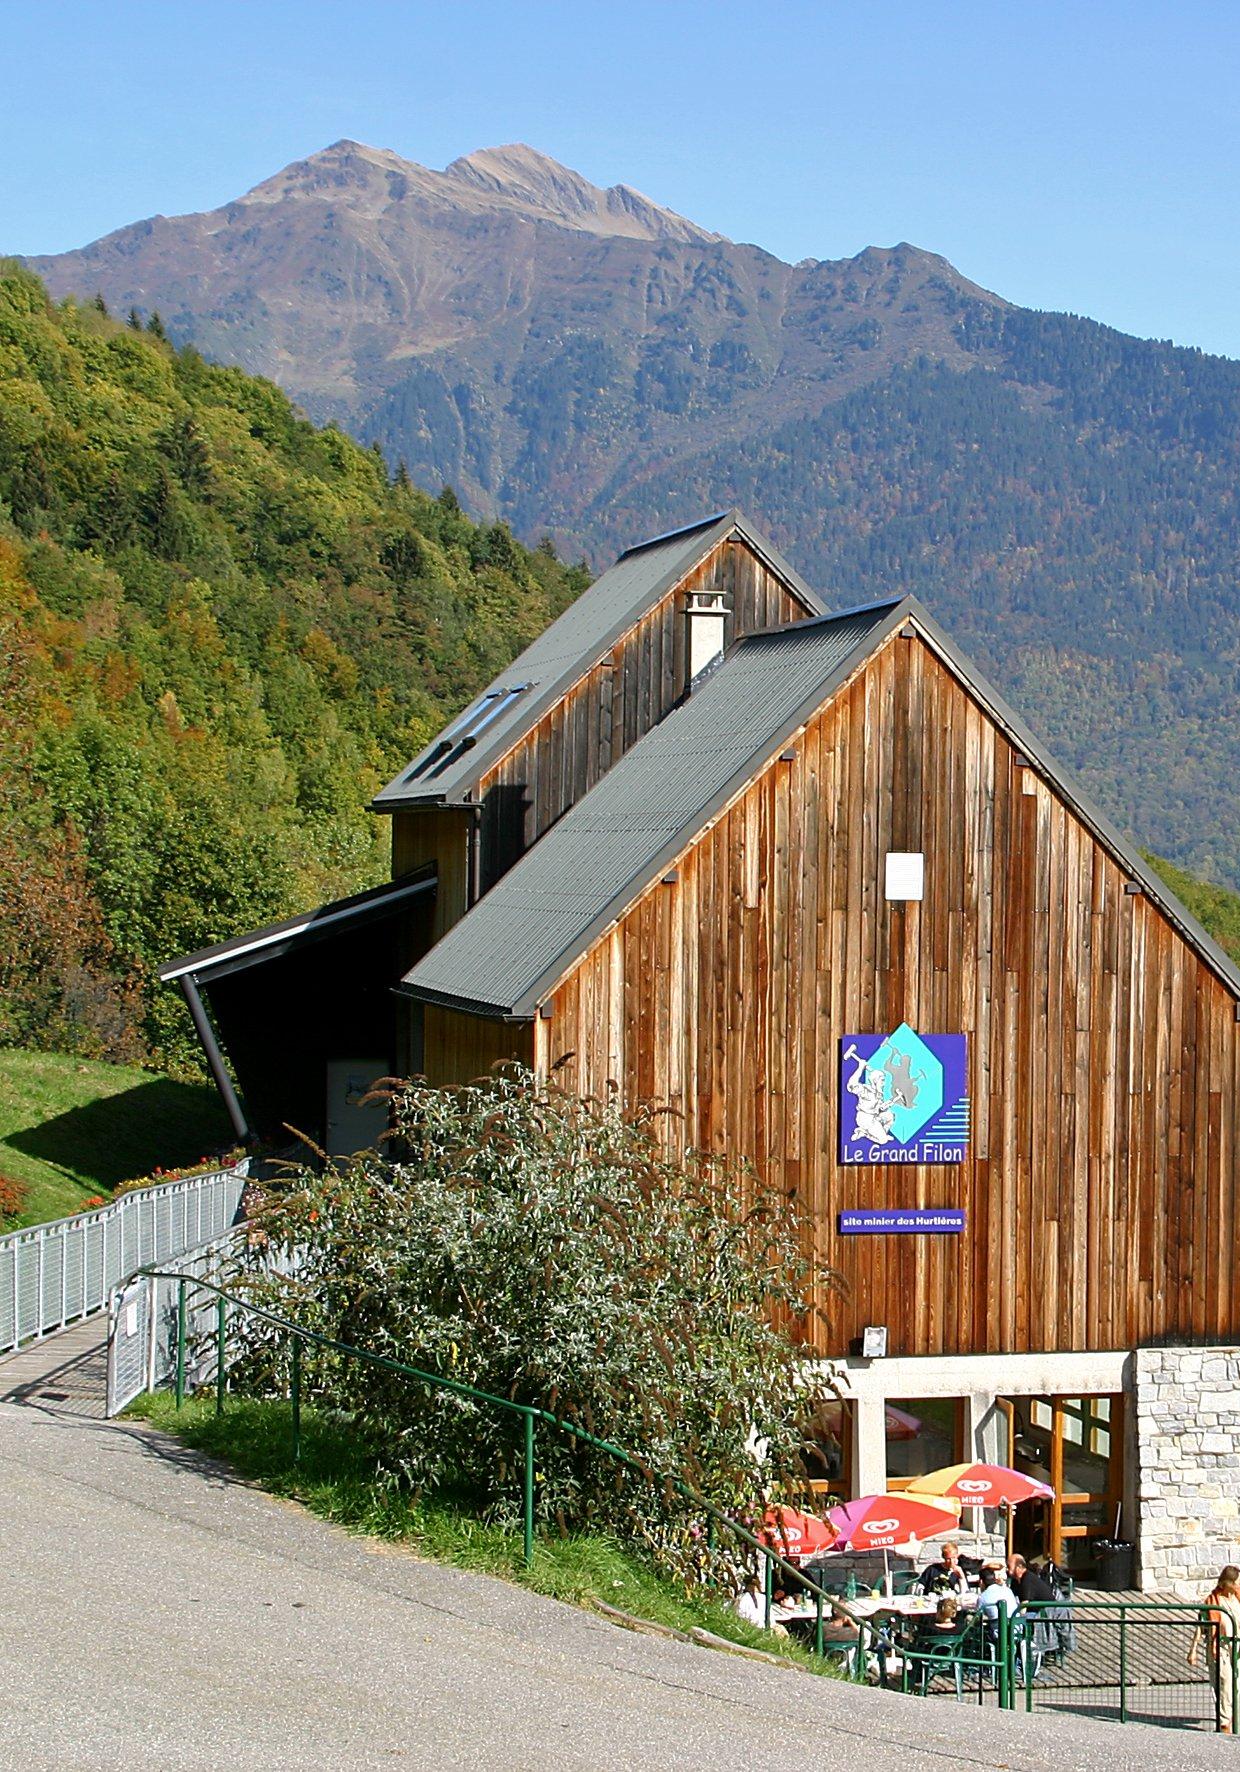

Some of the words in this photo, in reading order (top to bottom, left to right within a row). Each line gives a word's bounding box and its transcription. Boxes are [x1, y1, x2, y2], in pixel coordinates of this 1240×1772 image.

[844, 1145, 864, 1163] Le
[868, 1144, 918, 1162] Grand
[923, 1143, 962, 1162] Filon
[843, 1217, 862, 1226] site
[864, 1216, 895, 1226] minier
[897, 1216, 914, 1226] des
